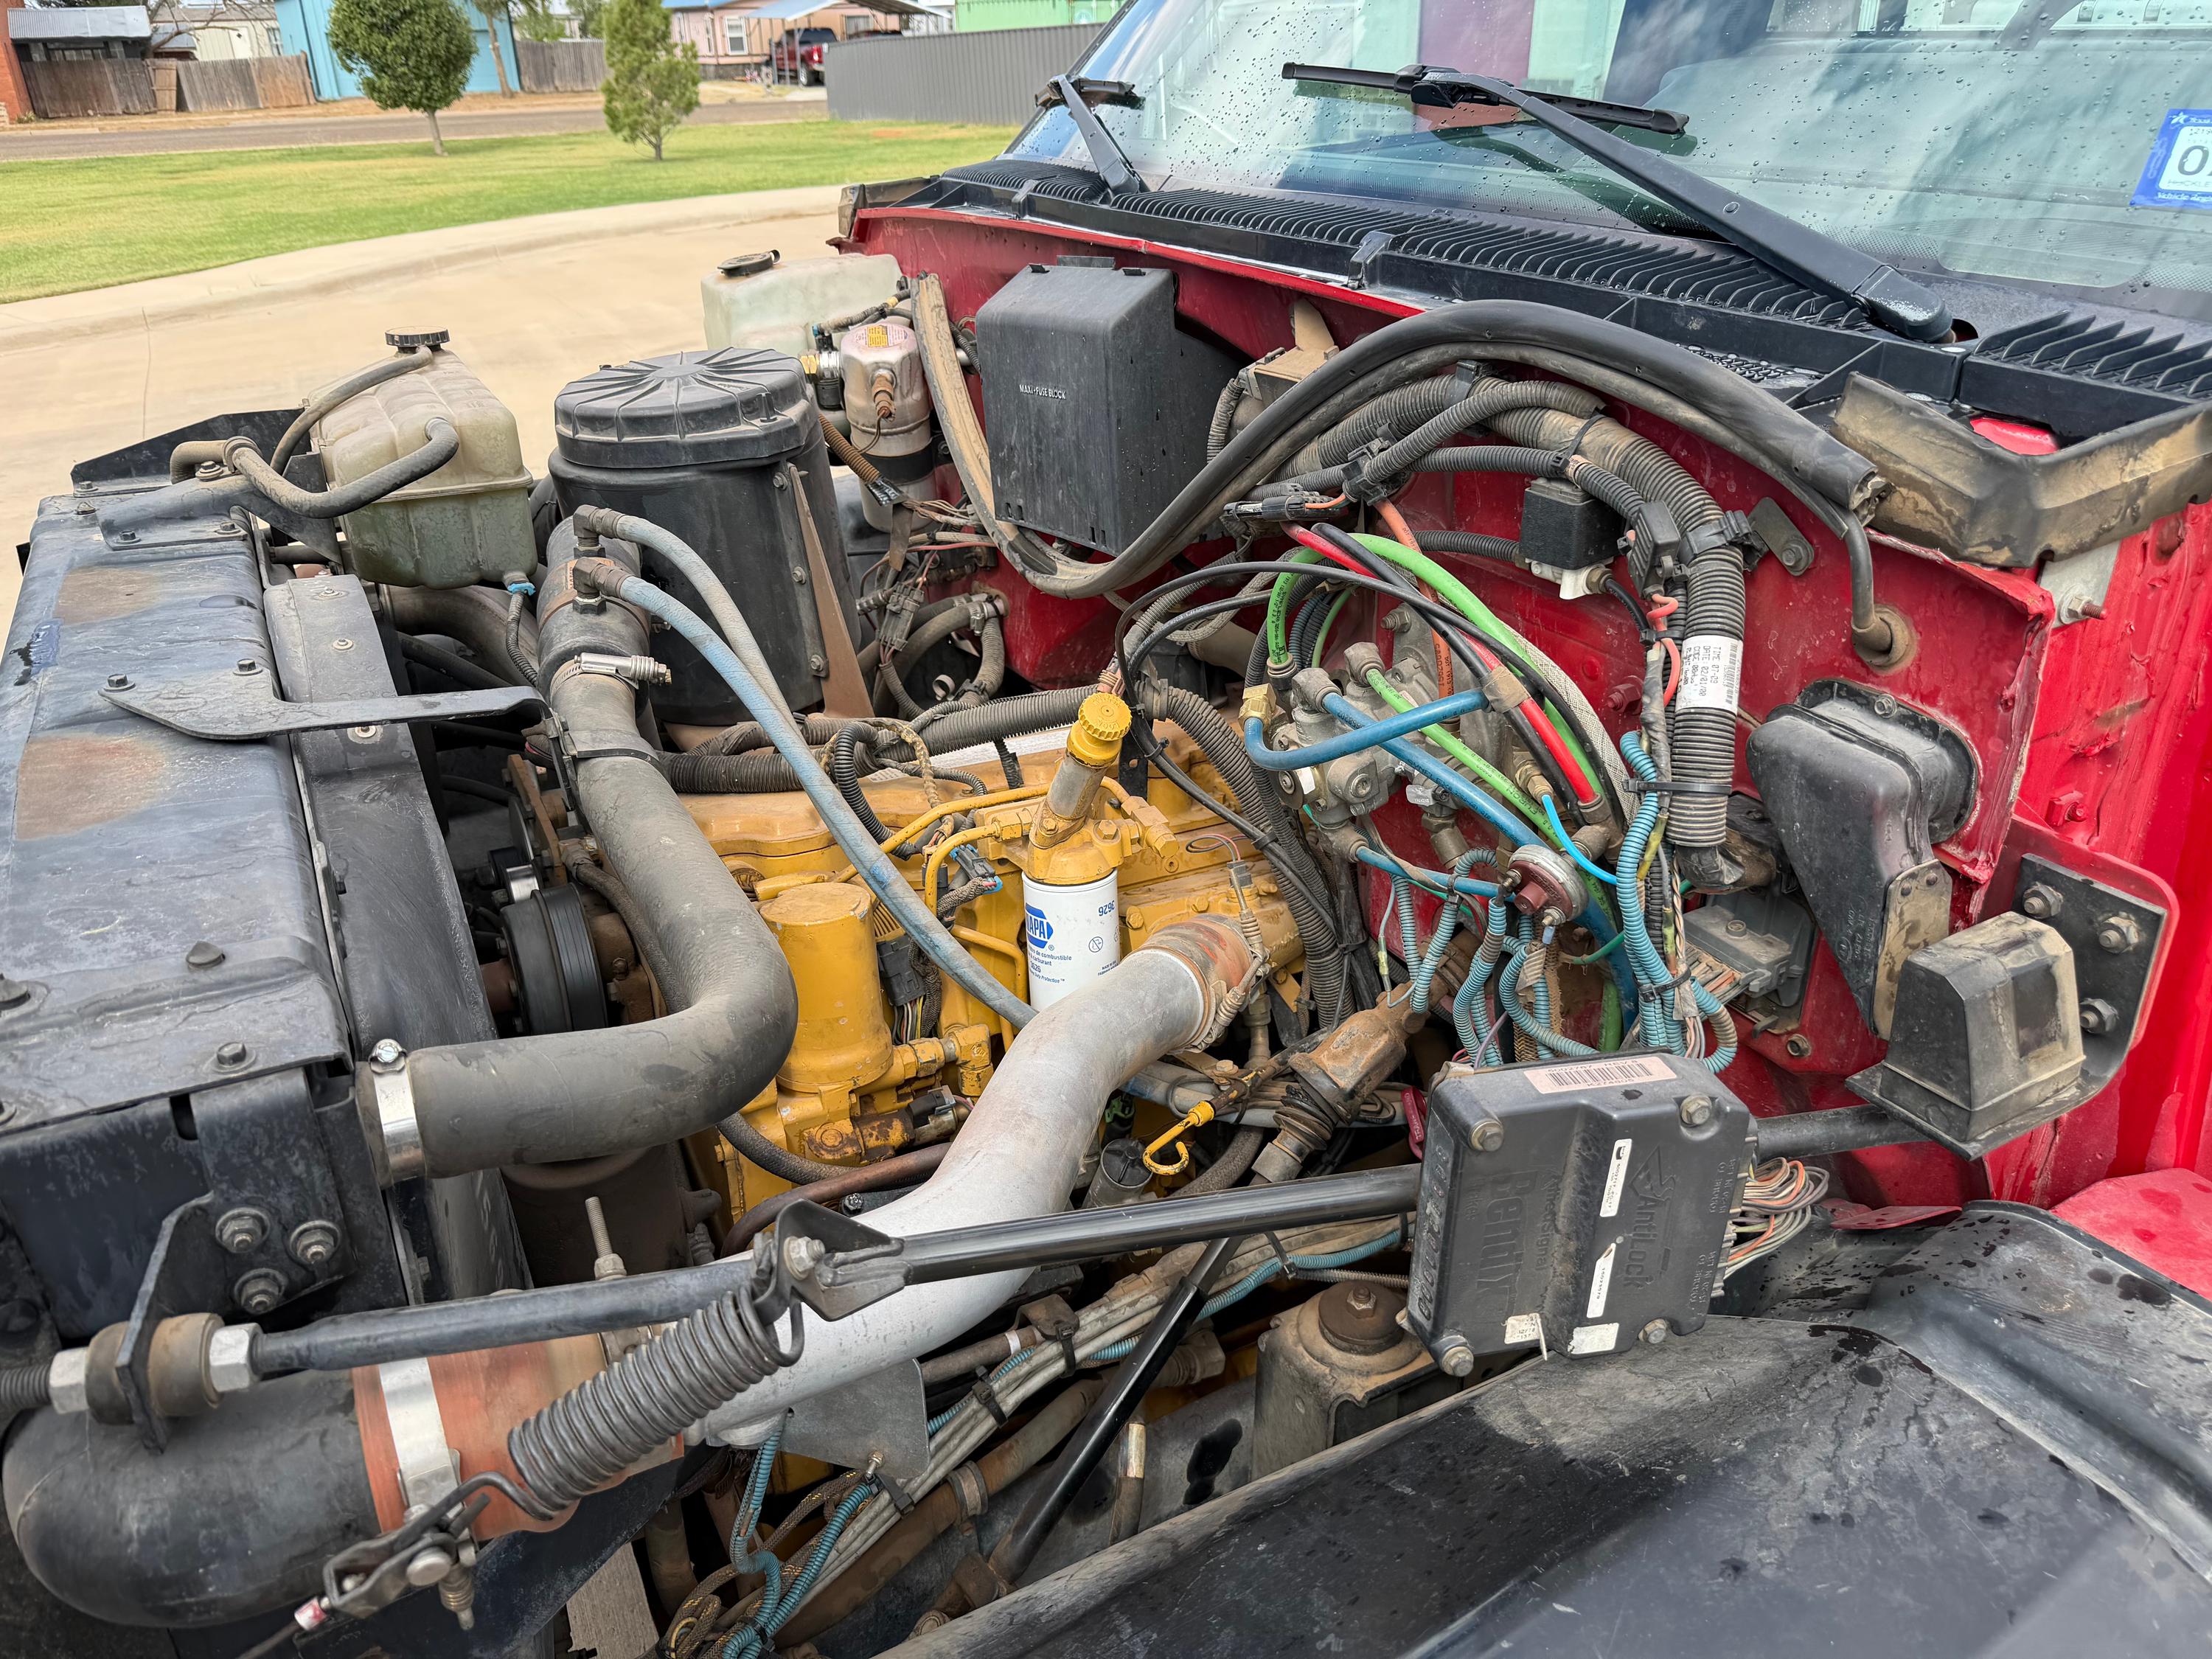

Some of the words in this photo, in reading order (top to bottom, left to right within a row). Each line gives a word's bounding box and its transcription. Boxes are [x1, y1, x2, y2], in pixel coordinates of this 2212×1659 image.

[2177, 145, 2212, 176] 0
[1048, 389, 1067, 400] BLOCK
[1506, 787, 1537, 815] FURON
[1098, 900, 1115, 916] 3626
[1032, 956, 1052, 966] carburant
[1041, 952, 1072, 961] combustible
[1475, 1170, 1538, 1294] Bendix
[1623, 1196, 1661, 1289] AntiLock
